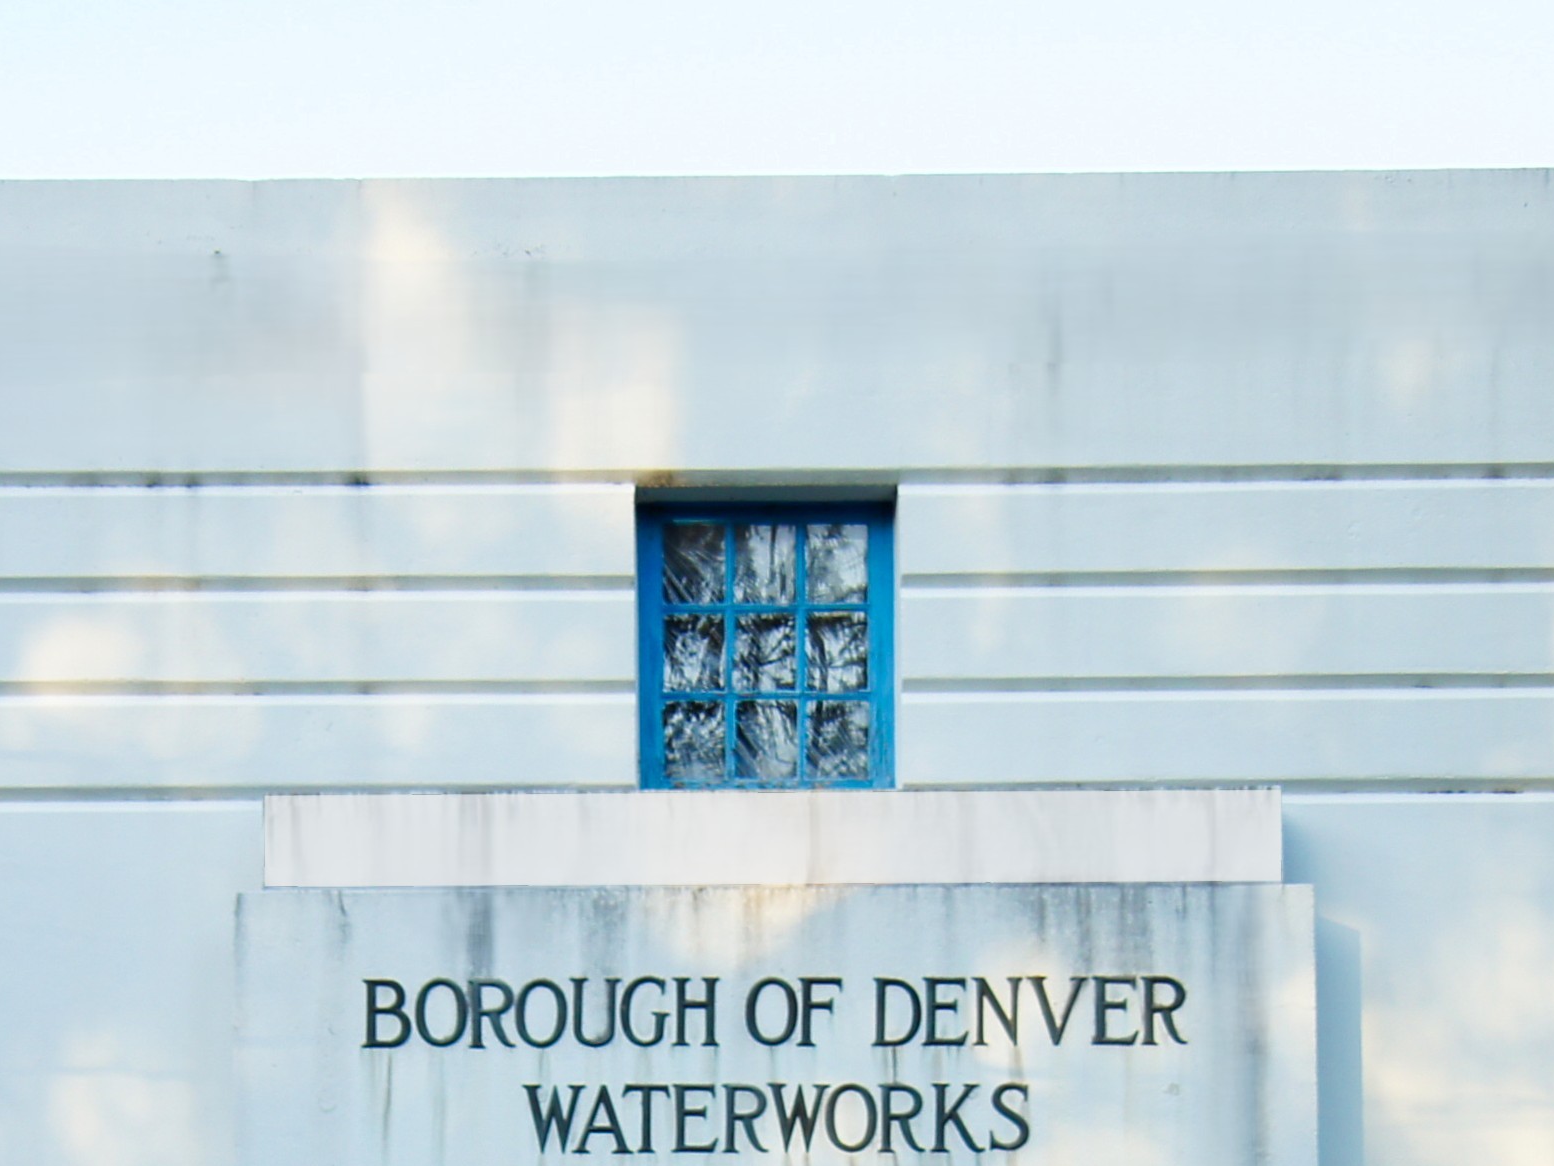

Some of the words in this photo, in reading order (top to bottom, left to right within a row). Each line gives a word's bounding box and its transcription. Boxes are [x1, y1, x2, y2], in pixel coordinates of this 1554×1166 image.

[361, 976, 719, 1050] BOROUGH
[745, 976, 843, 1048] OF
[873, 975, 1188, 1048] DENVER
[522, 1082, 1030, 1155] WATERWORKS
